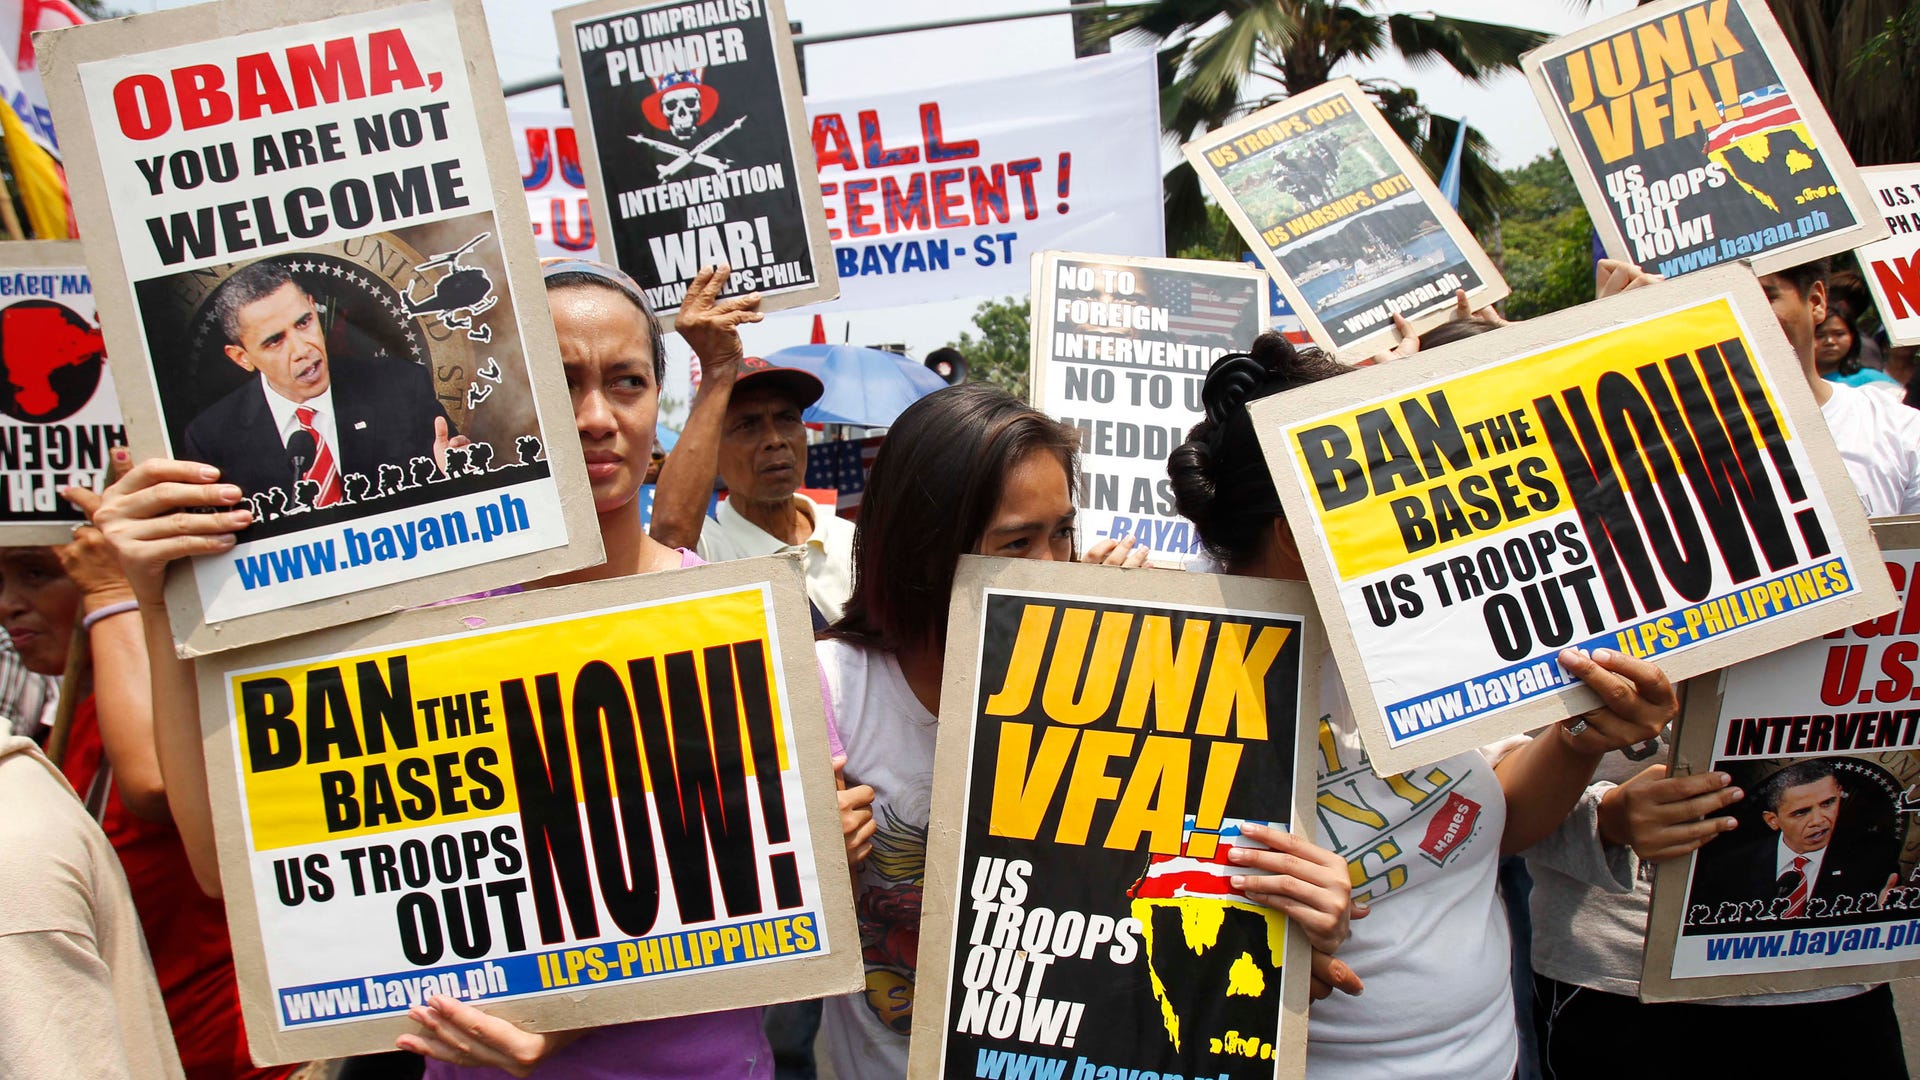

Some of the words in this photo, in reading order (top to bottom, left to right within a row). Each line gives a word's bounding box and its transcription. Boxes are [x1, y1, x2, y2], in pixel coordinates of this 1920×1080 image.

[577, 24, 608, 52] NO
[610, 16, 640, 43] TO
[641, 1, 762, 37] IMPRIALIST
[605, 27, 748, 87] PLUNDER
[1566, 0, 1744, 114] JUNK
[113, 28, 444, 141] OBAMA,
[1583, 58, 1744, 164] VFA!
[136, 141, 240, 195] YOU
[252, 121, 347, 172] ARE
[358, 101, 450, 154] NOT
[811, 101, 980, 173] ALL
[1207, 145, 1234, 168] US
[1234, 115, 1312, 158] TROOPS,
[1306, 97, 1353, 125] OUT!
[145, 159, 470, 266] WELCOME
[618, 163, 785, 219] INTERVENTION
[686, 202, 726, 230] AND
[1262, 225, 1291, 247] US
[1286, 190, 1377, 238] WARSHIPS,
[1371, 174, 1412, 201] OUT!
[1605, 165, 1645, 198] US
[1613, 162, 1727, 219] TROOPS
[1880, 188, 1915, 208] U.S.
[648, 215, 776, 284] WAR!
[1625, 200, 1682, 240] OUT
[1634, 213, 1715, 263] NOW!
[1658, 209, 1829, 279] www.bayan.ph
[1885, 213, 1912, 235] PH
[1057, 299, 1169, 332] FOREIGN
[1058, 266, 1095, 292] NO
[1102, 270, 1136, 296] TO
[1343, 272, 1462, 334] www.bayan.ph
[1064, 366, 1115, 404] NO
[1125, 371, 1173, 410] TO
[1297, 390, 1475, 511] BAN
[1463, 408, 1537, 460] THE
[1532, 336, 1833, 623] NOW!
[1390, 456, 1561, 553] BASES
[235, 493, 530, 591] www.bayan.ph
[1361, 573, 1424, 628] US
[1424, 521, 1588, 609] TROOPS
[1482, 565, 1605, 662] OUT
[1616, 561, 1850, 659] ILPS-PHILIPPINES
[985, 604, 1292, 741] JUNK
[1390, 646, 1594, 736] www.bayan.
[1820, 641, 1920, 706] U.S.
[240, 655, 418, 773] BAN
[417, 688, 495, 739] THE
[321, 745, 506, 834] BASES
[500, 638, 803, 947] NOW!
[988, 722, 1245, 859] VFA!
[1433, 802, 1470, 853] Hanes
[273, 853, 335, 907] US
[341, 825, 523, 896] TROOPS
[970, 856, 1033, 906] US
[397, 877, 527, 967] OUT
[538, 912, 816, 990] ILPS-PHILIPPINES
[969, 901, 1143, 966] TROOPS
[1707, 920, 1920, 961] www.bayan.ph
[283, 958, 508, 1022] www.bayan.ph
[962, 945, 1055, 999] OUT
[956, 994, 1085, 1049] NOW!
